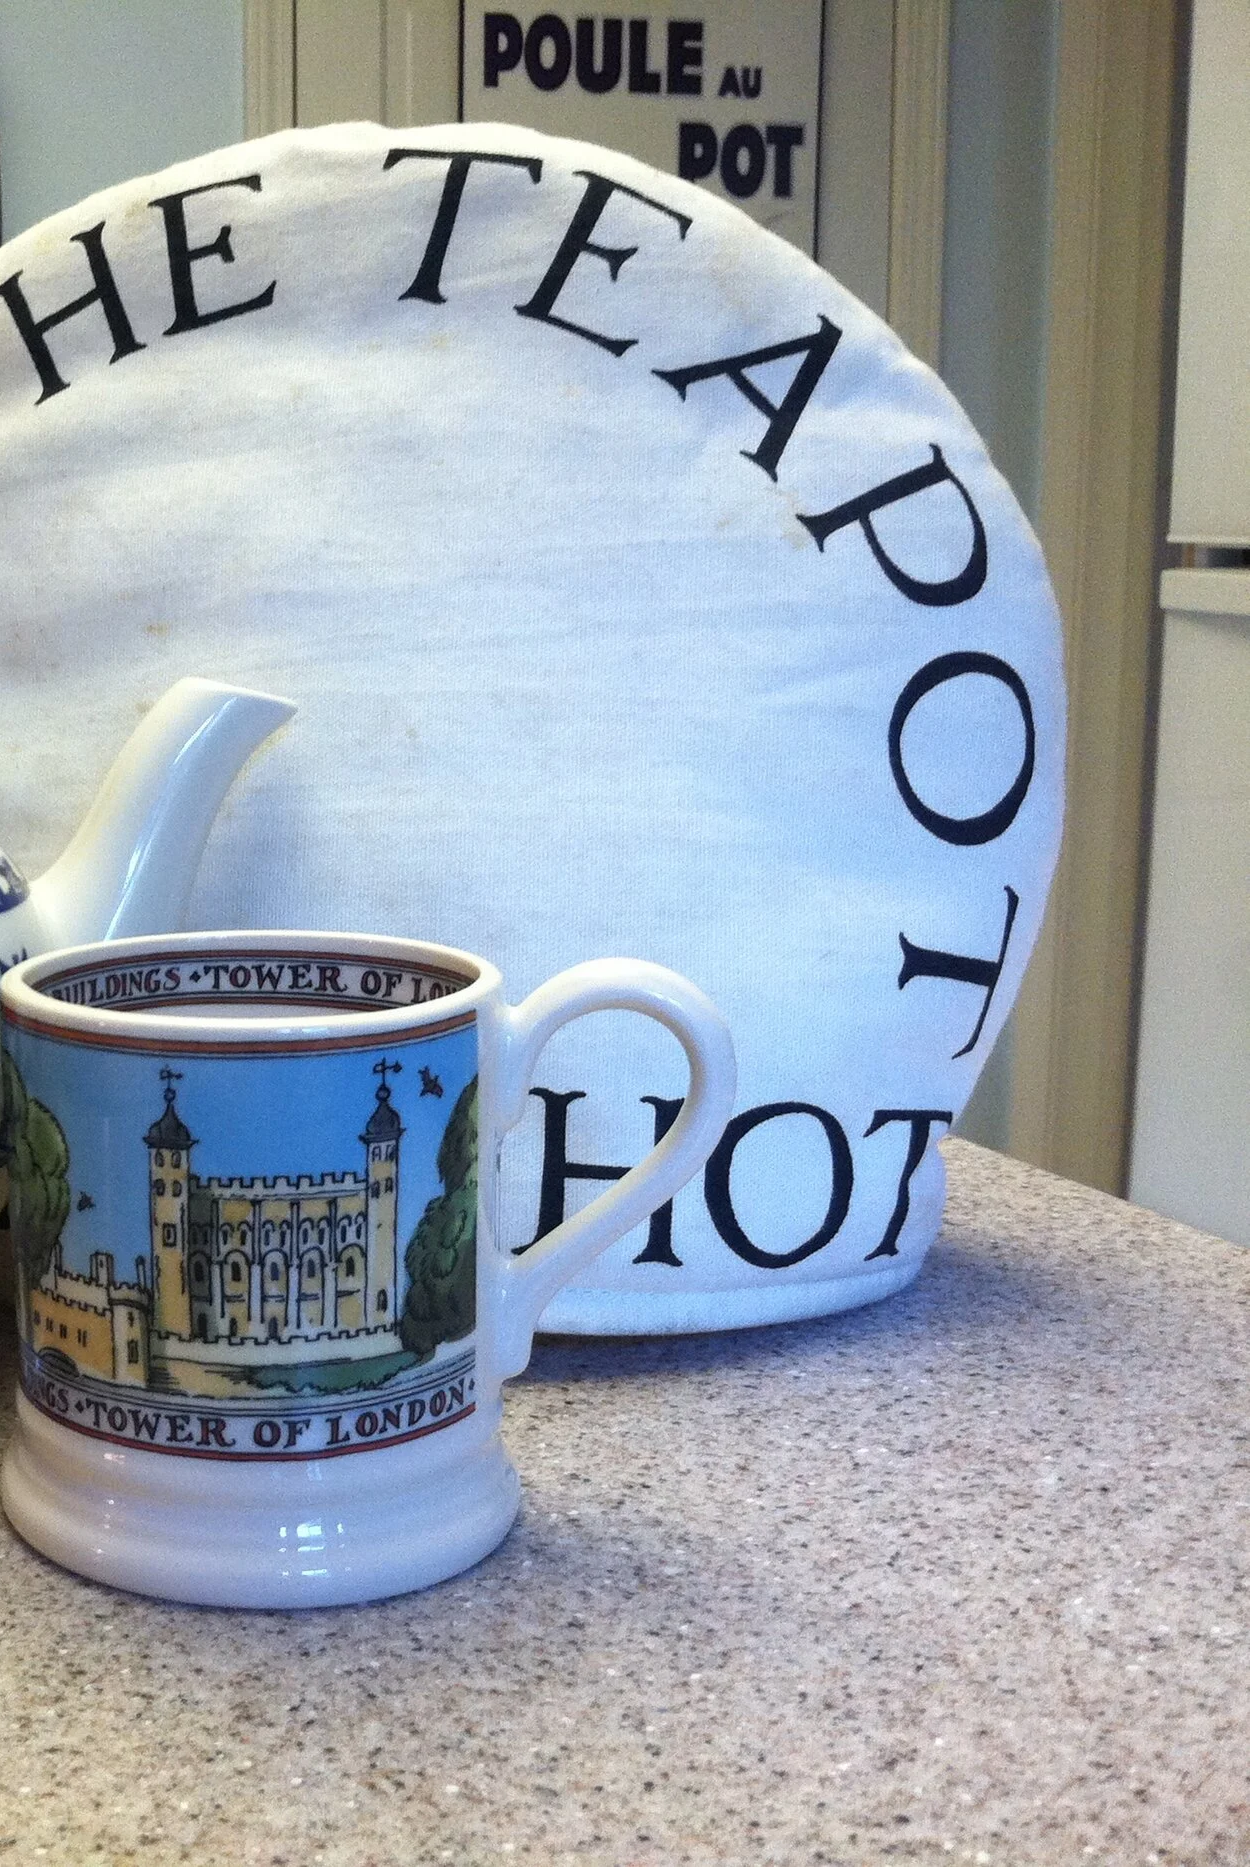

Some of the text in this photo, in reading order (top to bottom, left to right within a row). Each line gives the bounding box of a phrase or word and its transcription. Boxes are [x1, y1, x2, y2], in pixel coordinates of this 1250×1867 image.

[483, 12, 763, 99] POULE AU
[677, 121, 806, 199] POT
[382, 147, 1036, 1060] TEAPOT
[203, 962, 350, 994] TOWER
[360, 969, 403, 999] OF
[511, 1087, 954, 1270] HOT
[85, 1397, 236, 1447] TOWER
[253, 1418, 314, 1449] OF
[325, 1379, 468, 1446] LONDON
